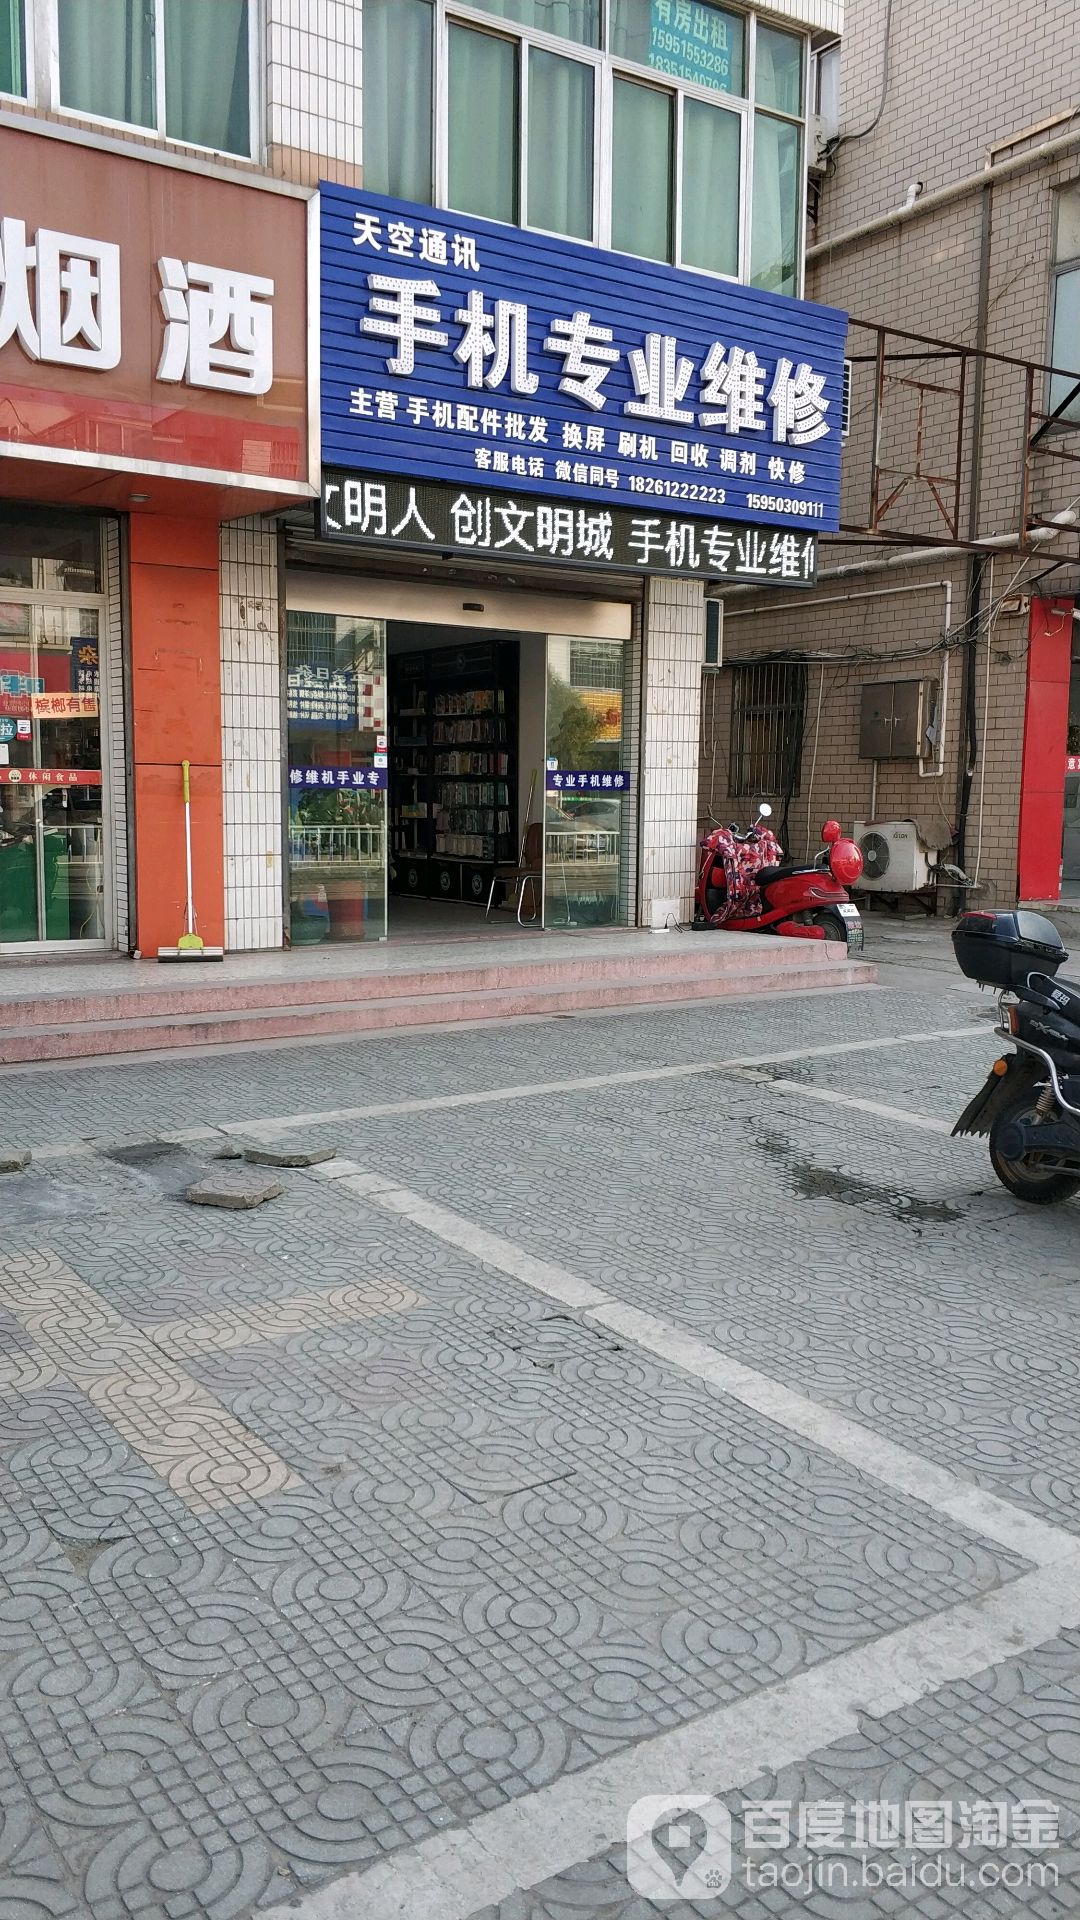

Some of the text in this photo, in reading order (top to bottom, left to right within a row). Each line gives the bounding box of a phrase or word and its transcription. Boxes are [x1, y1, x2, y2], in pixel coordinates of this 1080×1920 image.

[652, 27, 728, 76] 15951553286
[655, 0, 728, 51] 有房出租
[352, 212, 480, 271] 天空通讯
[0, 217, 274, 394] 烟酒
[360, 273, 832, 445] 手机专业维修
[350, 388, 805, 485] 主营 手机配件批发 换屏 刷机 回收 调剂 快修
[475, 447, 824, 518] 客服电话 微信同号 18261222223 15950309111
[451, 493, 613, 561] 创文明城
[34, 696, 97, 715] 槟榔有售
[28, 771, 78, 782] 休闲食品
[289, 769, 380, 786] 修维机手业专
[552, 773, 625, 788] 专业手机维修
